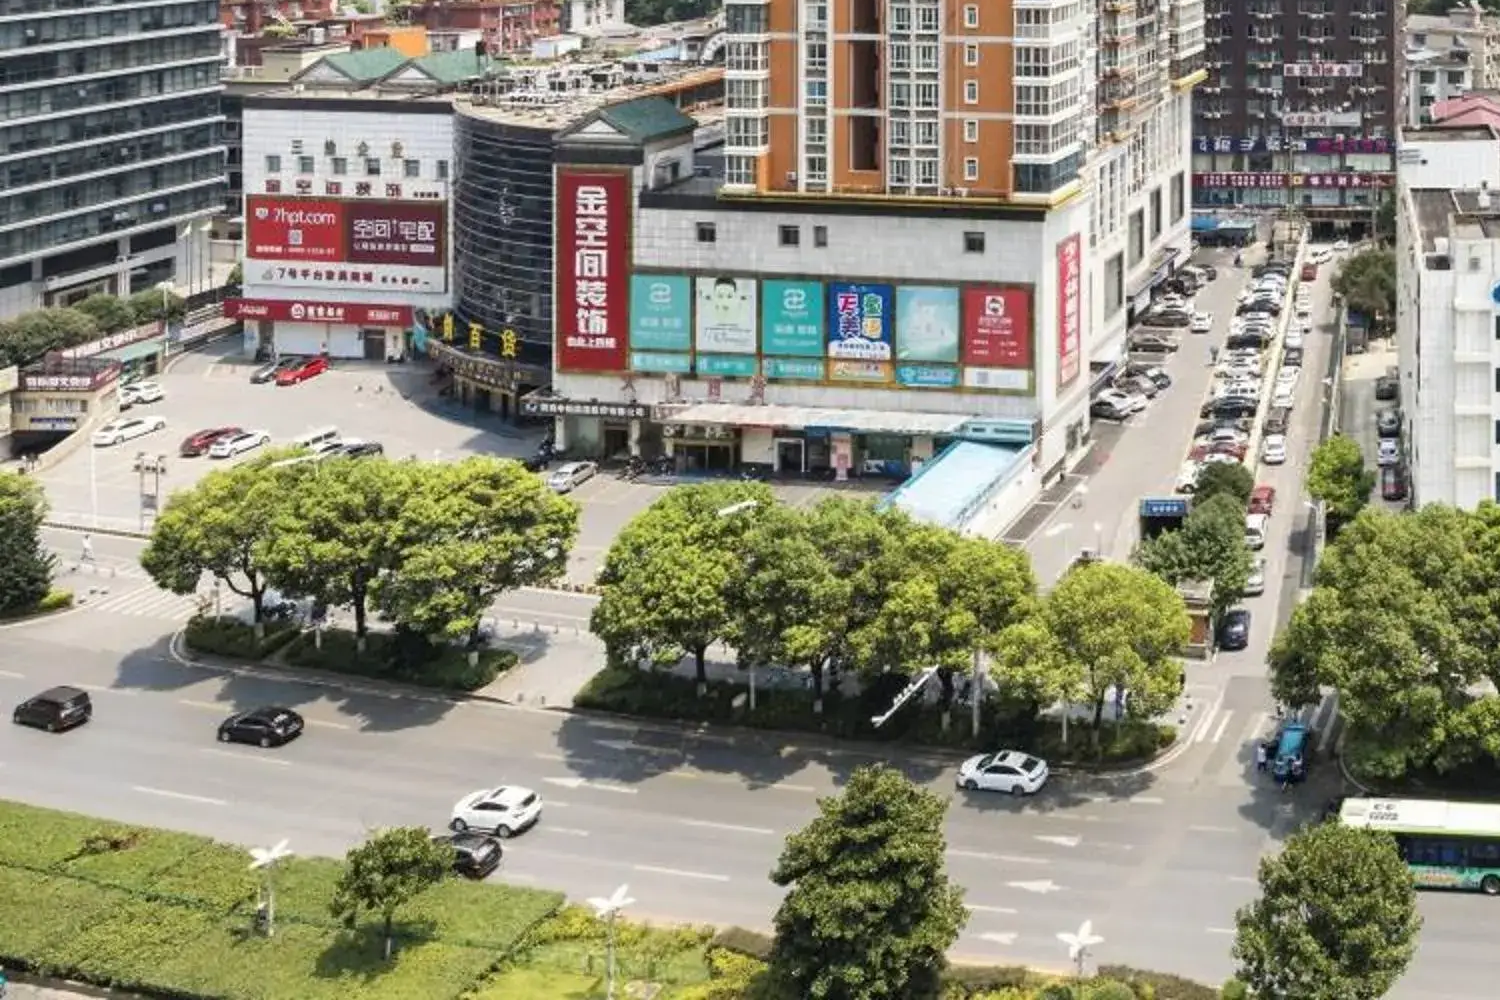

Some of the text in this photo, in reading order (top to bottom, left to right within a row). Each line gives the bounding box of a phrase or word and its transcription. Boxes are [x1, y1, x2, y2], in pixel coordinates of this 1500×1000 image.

[575, 186, 608, 334] 金空间装饰
